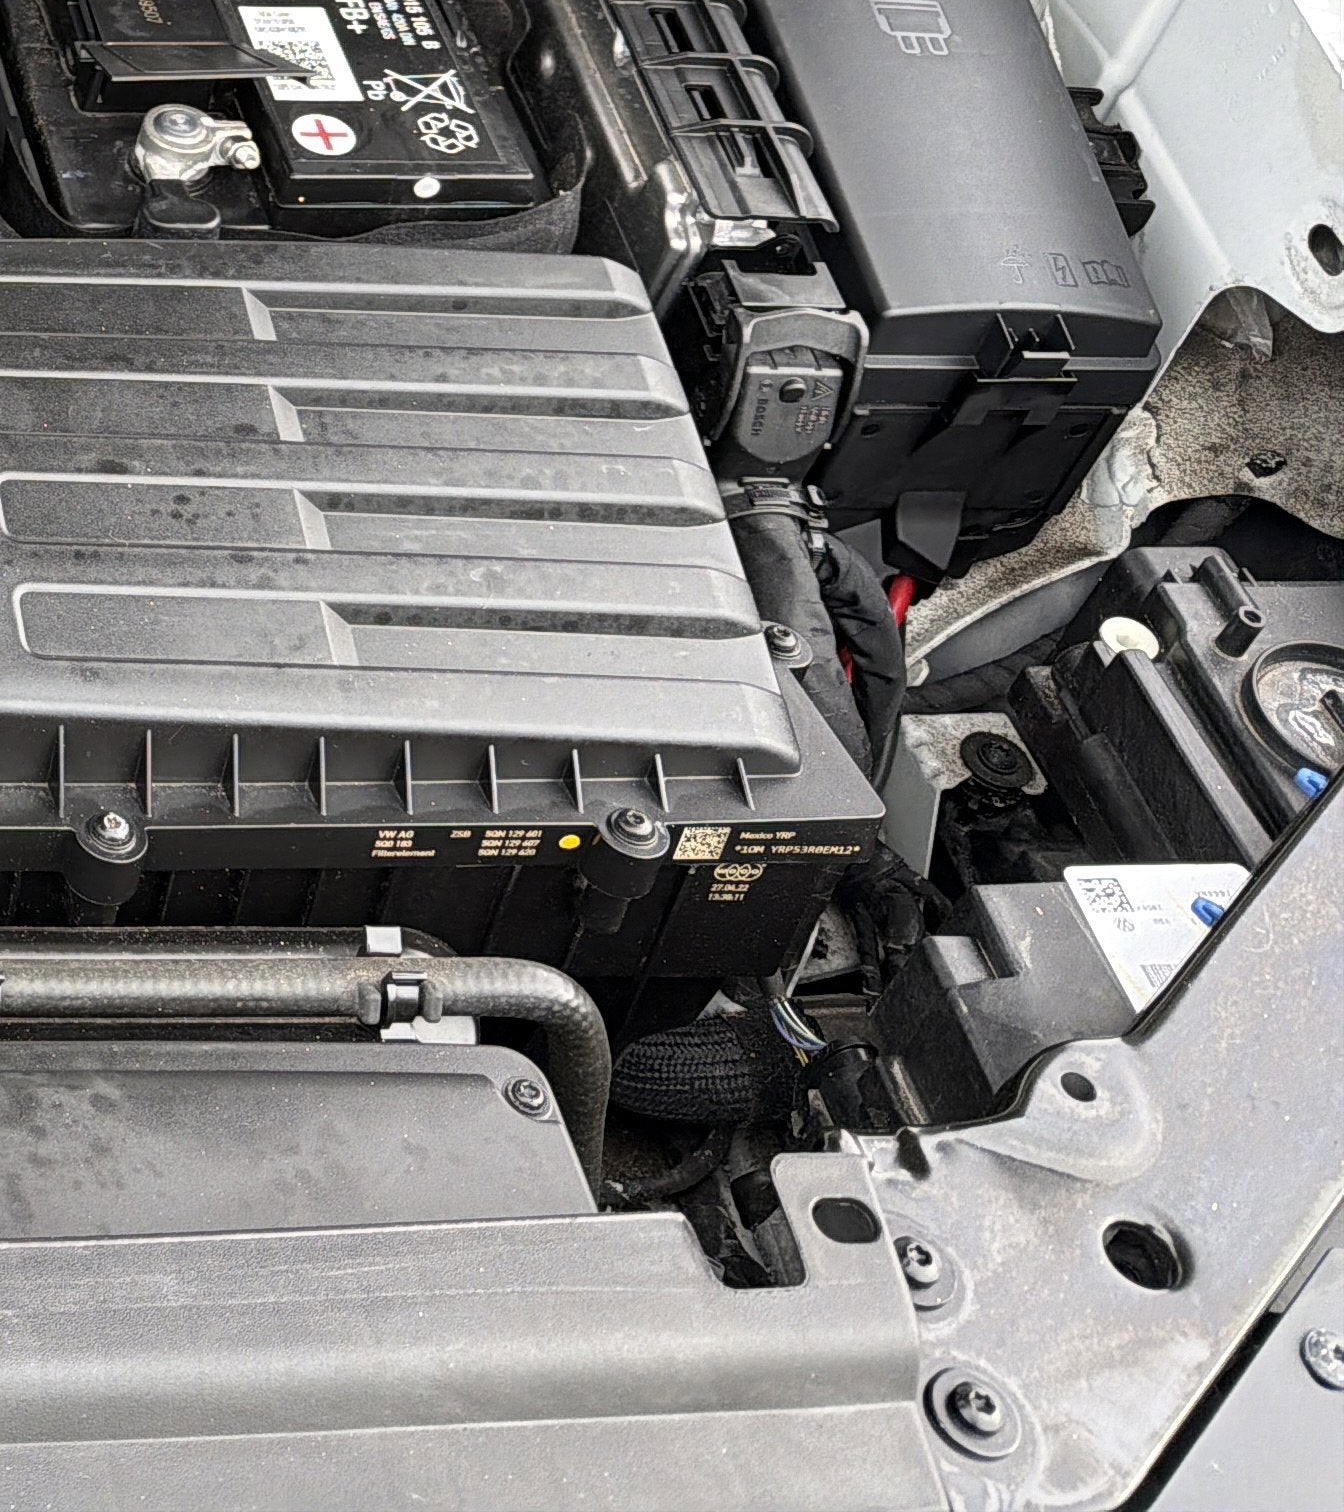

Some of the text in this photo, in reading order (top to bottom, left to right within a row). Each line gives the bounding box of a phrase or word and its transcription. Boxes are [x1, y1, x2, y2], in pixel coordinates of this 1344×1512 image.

[411, 15, 436, 37] 105
[421, 40, 442, 50] B
[362, 79, 388, 101] Pb
[378, 830, 414, 838] VW AG
[508, 830, 524, 838] 129
[526, 830, 543, 838] 601
[739, 831, 797, 839] Mexico YRP
[504, 839, 520, 847] 129
[522, 839, 541, 847] 607
[371, 849, 436, 858] Filterelement
[501, 848, 516, 857] 129
[518, 848, 537, 857] 620
